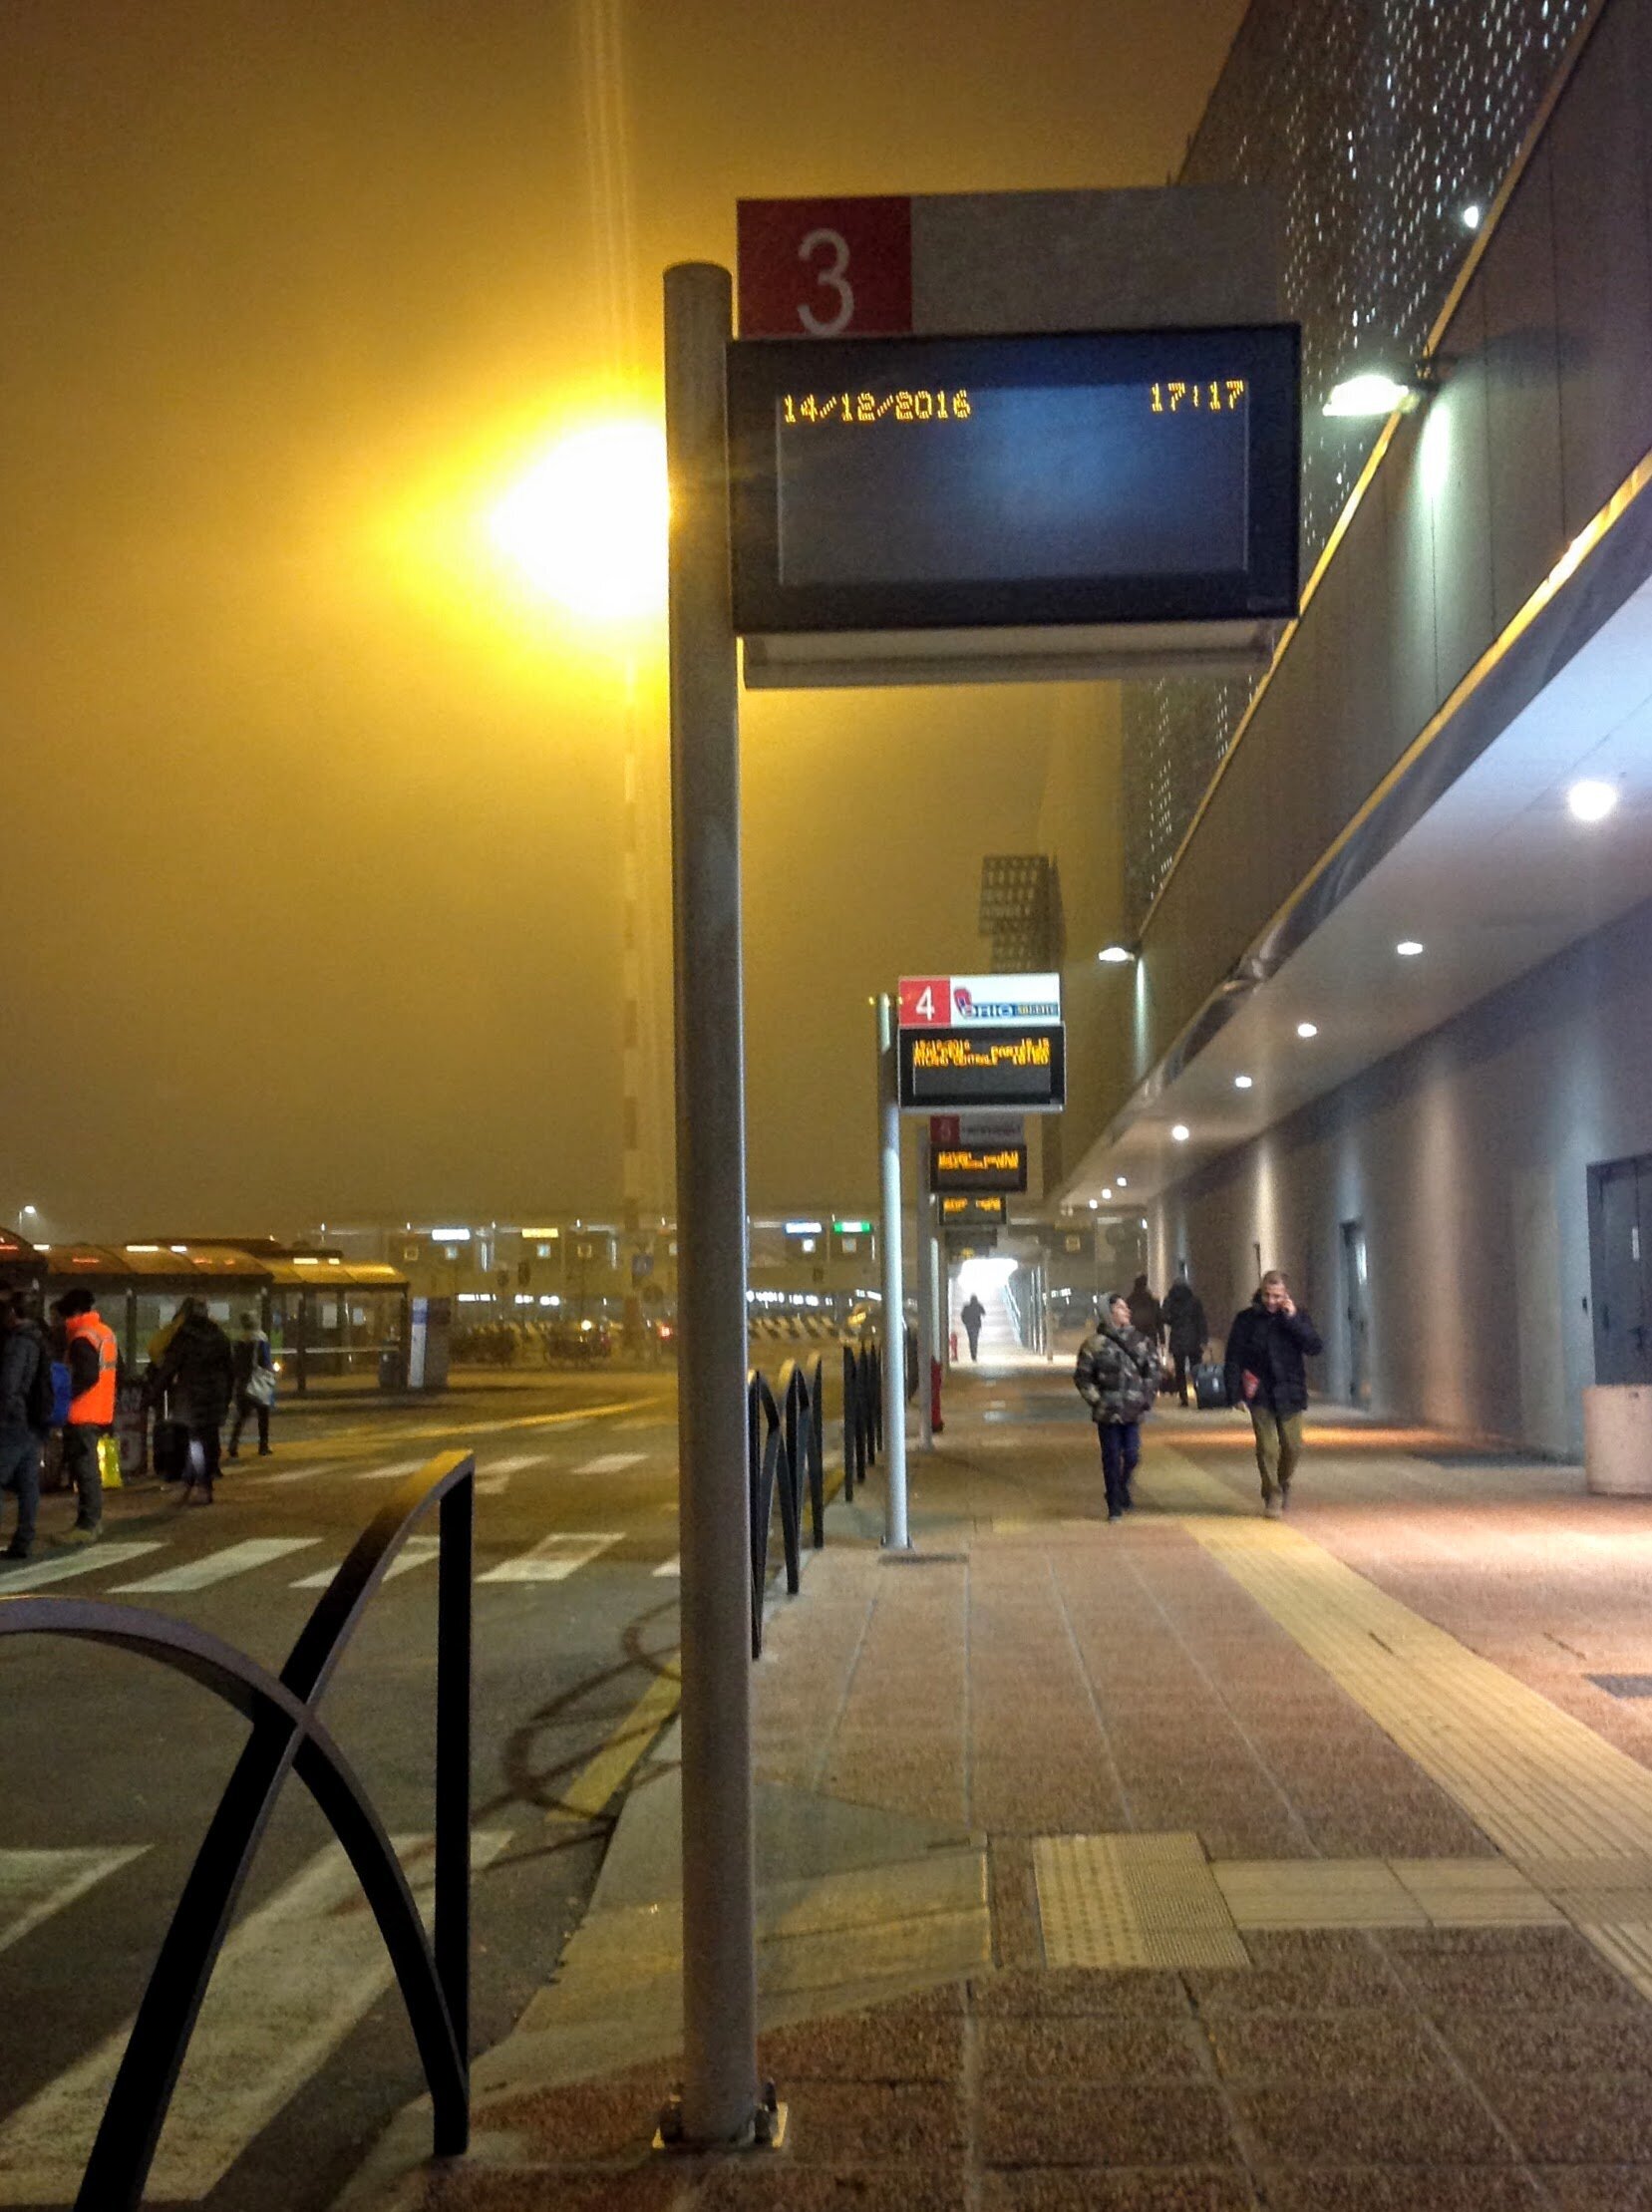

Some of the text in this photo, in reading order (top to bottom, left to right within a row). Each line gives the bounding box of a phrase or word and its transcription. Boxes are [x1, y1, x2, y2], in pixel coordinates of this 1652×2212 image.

[798, 227, 854, 336] 3
[785, 378, 1244, 423] 14/12/2016 17:17
[915, 985, 935, 1022] 4
